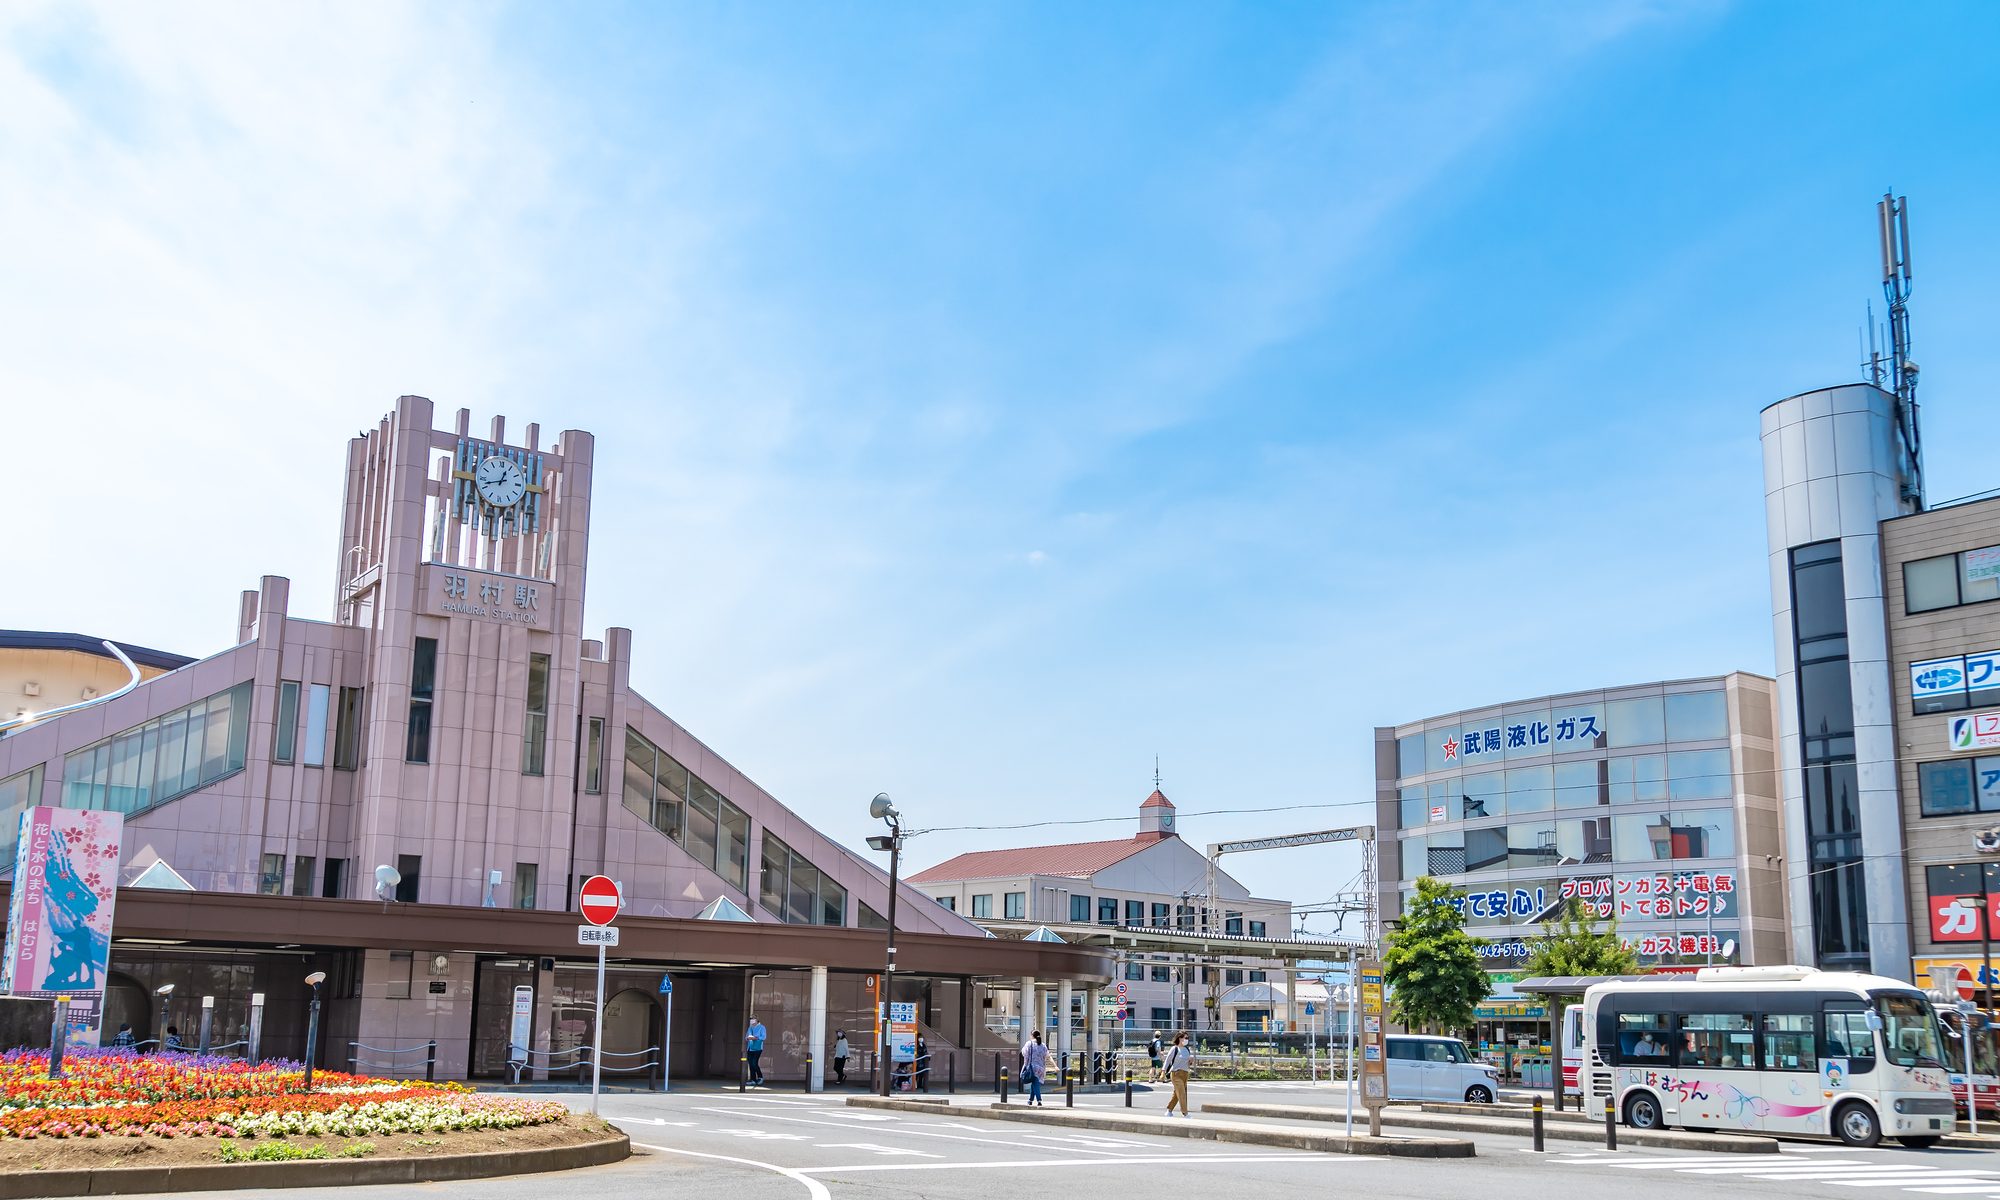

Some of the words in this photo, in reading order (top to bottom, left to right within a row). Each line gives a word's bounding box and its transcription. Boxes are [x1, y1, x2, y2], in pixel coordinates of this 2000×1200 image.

[444, 572, 539, 611] 羽村駅
[441, 601, 487, 617] HAMURA
[492, 608, 539, 624] STATION
[1968, 658, 2000, 684] ワ
[26, 823, 49, 905] 花と水のまち
[20, 919, 38, 961] はむら
[581, 930, 616, 942] 自転車を除く
[1645, 1070, 1709, 1102] はむらん
